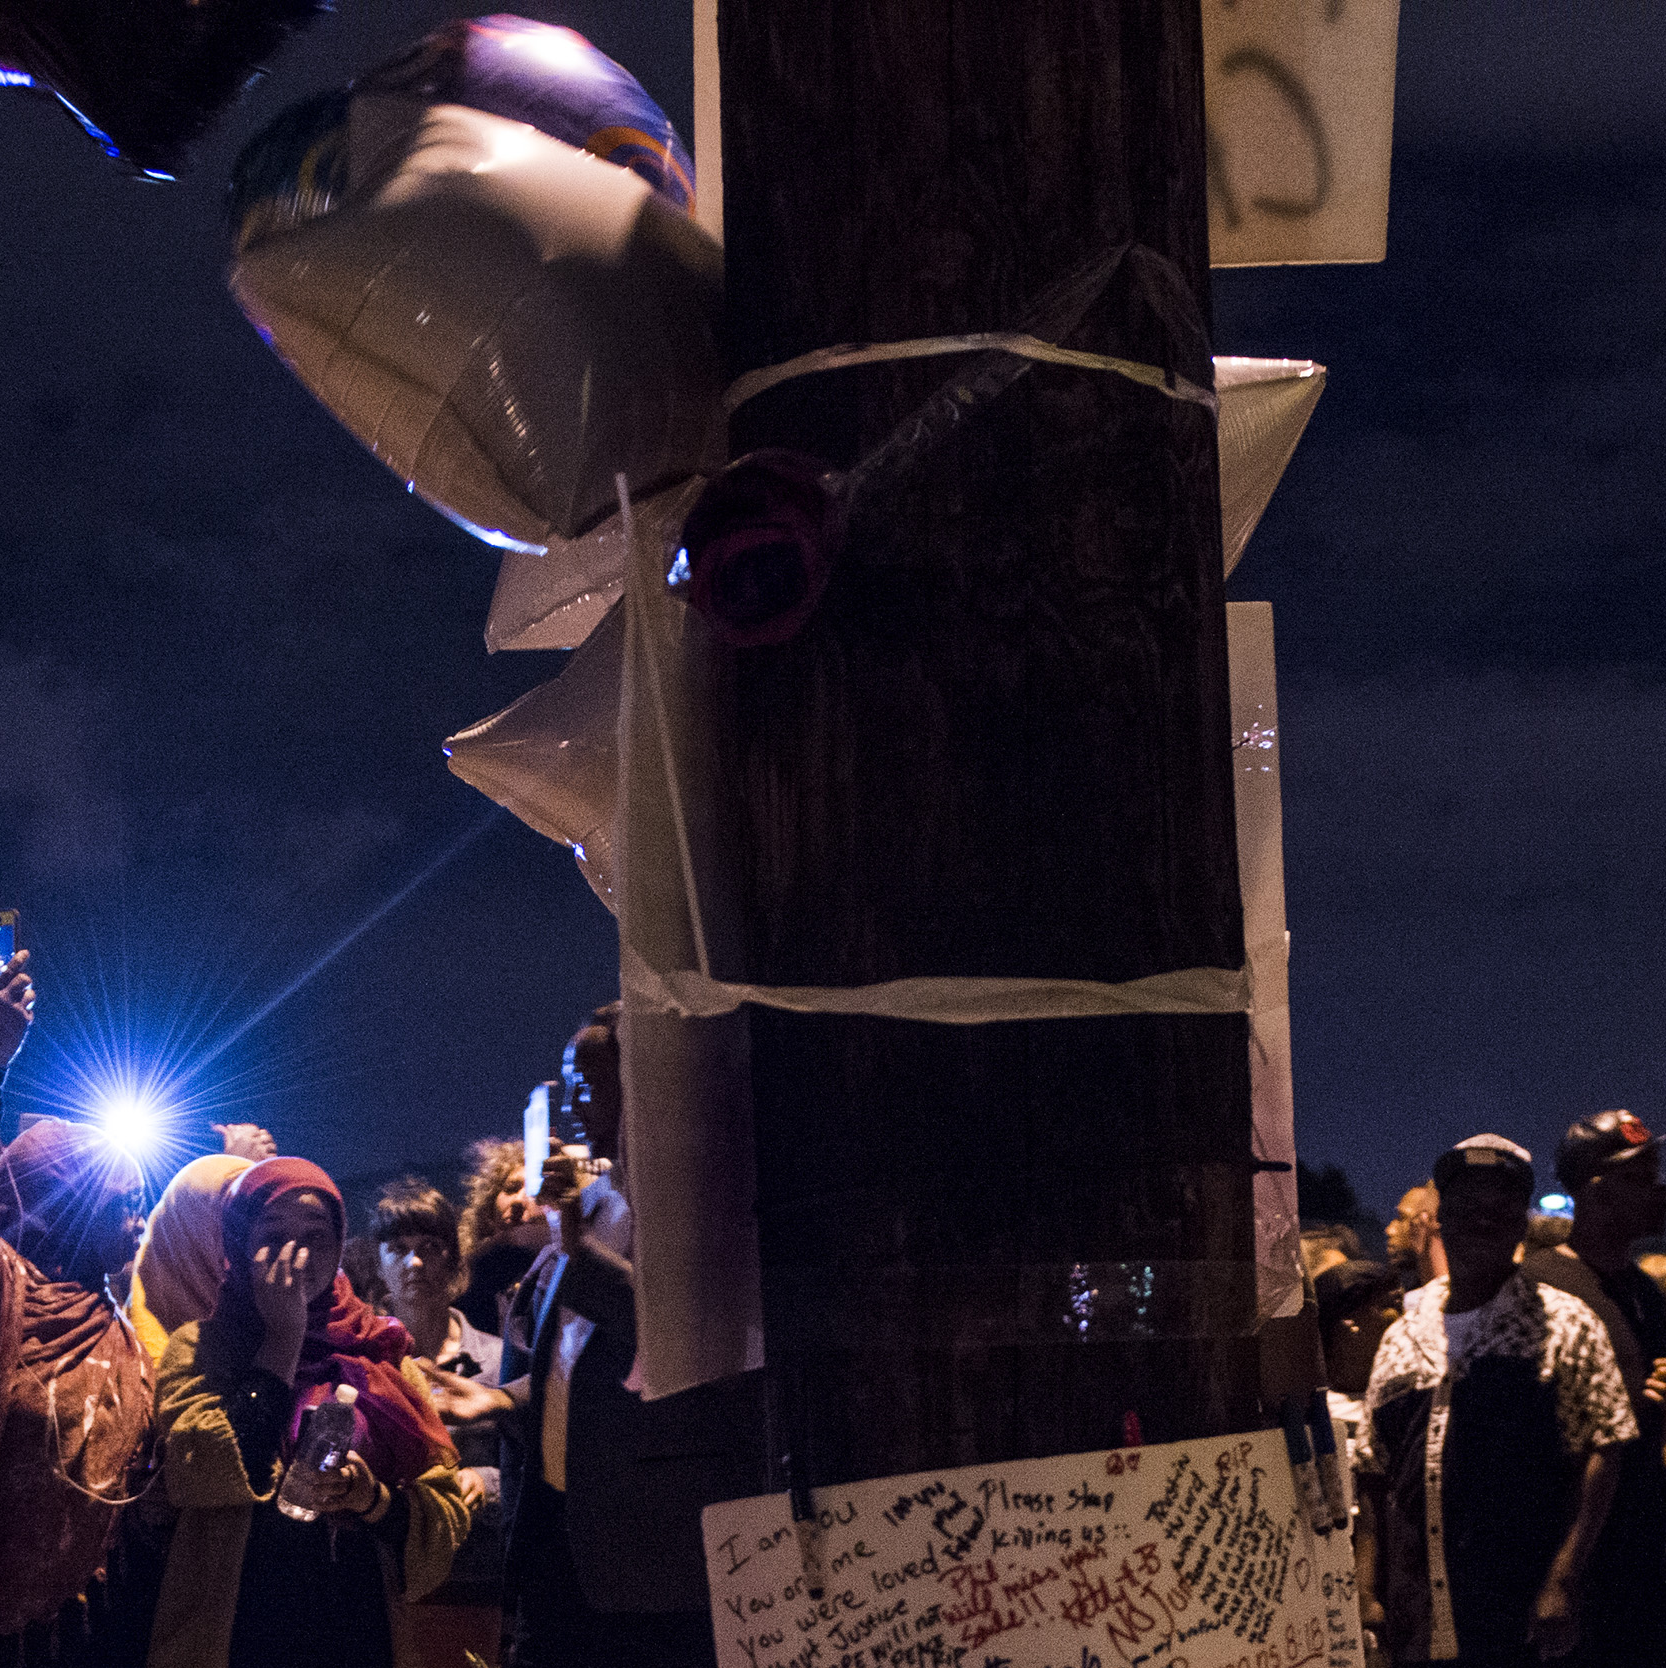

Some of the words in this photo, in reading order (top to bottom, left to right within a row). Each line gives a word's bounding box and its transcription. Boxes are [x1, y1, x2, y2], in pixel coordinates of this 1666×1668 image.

[718, 1534, 751, 1576] I
[758, 1526, 792, 1552] am
[833, 1540, 874, 1574] me
[797, 1590, 865, 1632] were
[873, 1541, 939, 1593] loved
